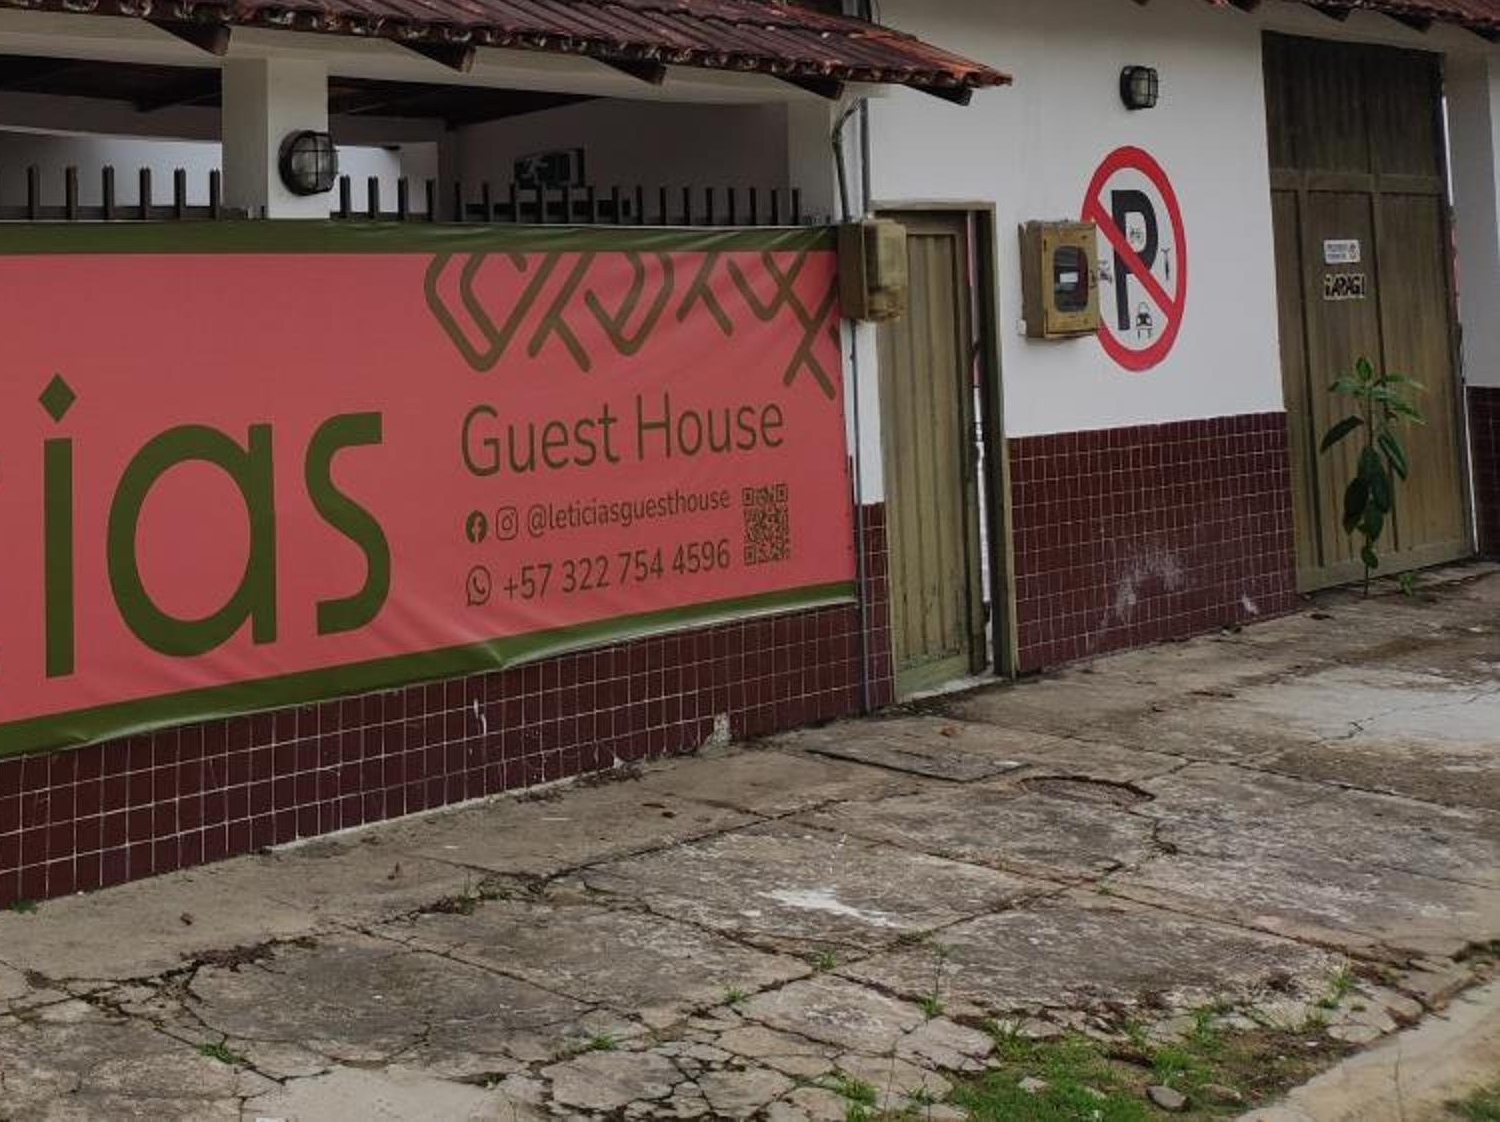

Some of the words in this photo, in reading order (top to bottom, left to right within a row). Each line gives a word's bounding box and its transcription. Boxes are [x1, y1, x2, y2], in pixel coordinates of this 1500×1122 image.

[1111, 189, 1159, 330] P
[462, 404, 619, 476] Guest
[637, 392, 784, 459] House
[527, 489, 731, 538] @leticiasguesthouse
[503, 563, 553, 600] +57
[562, 555, 610, 593] 322
[617, 548, 664, 582] 754
[672, 539, 731, 574] 4596
